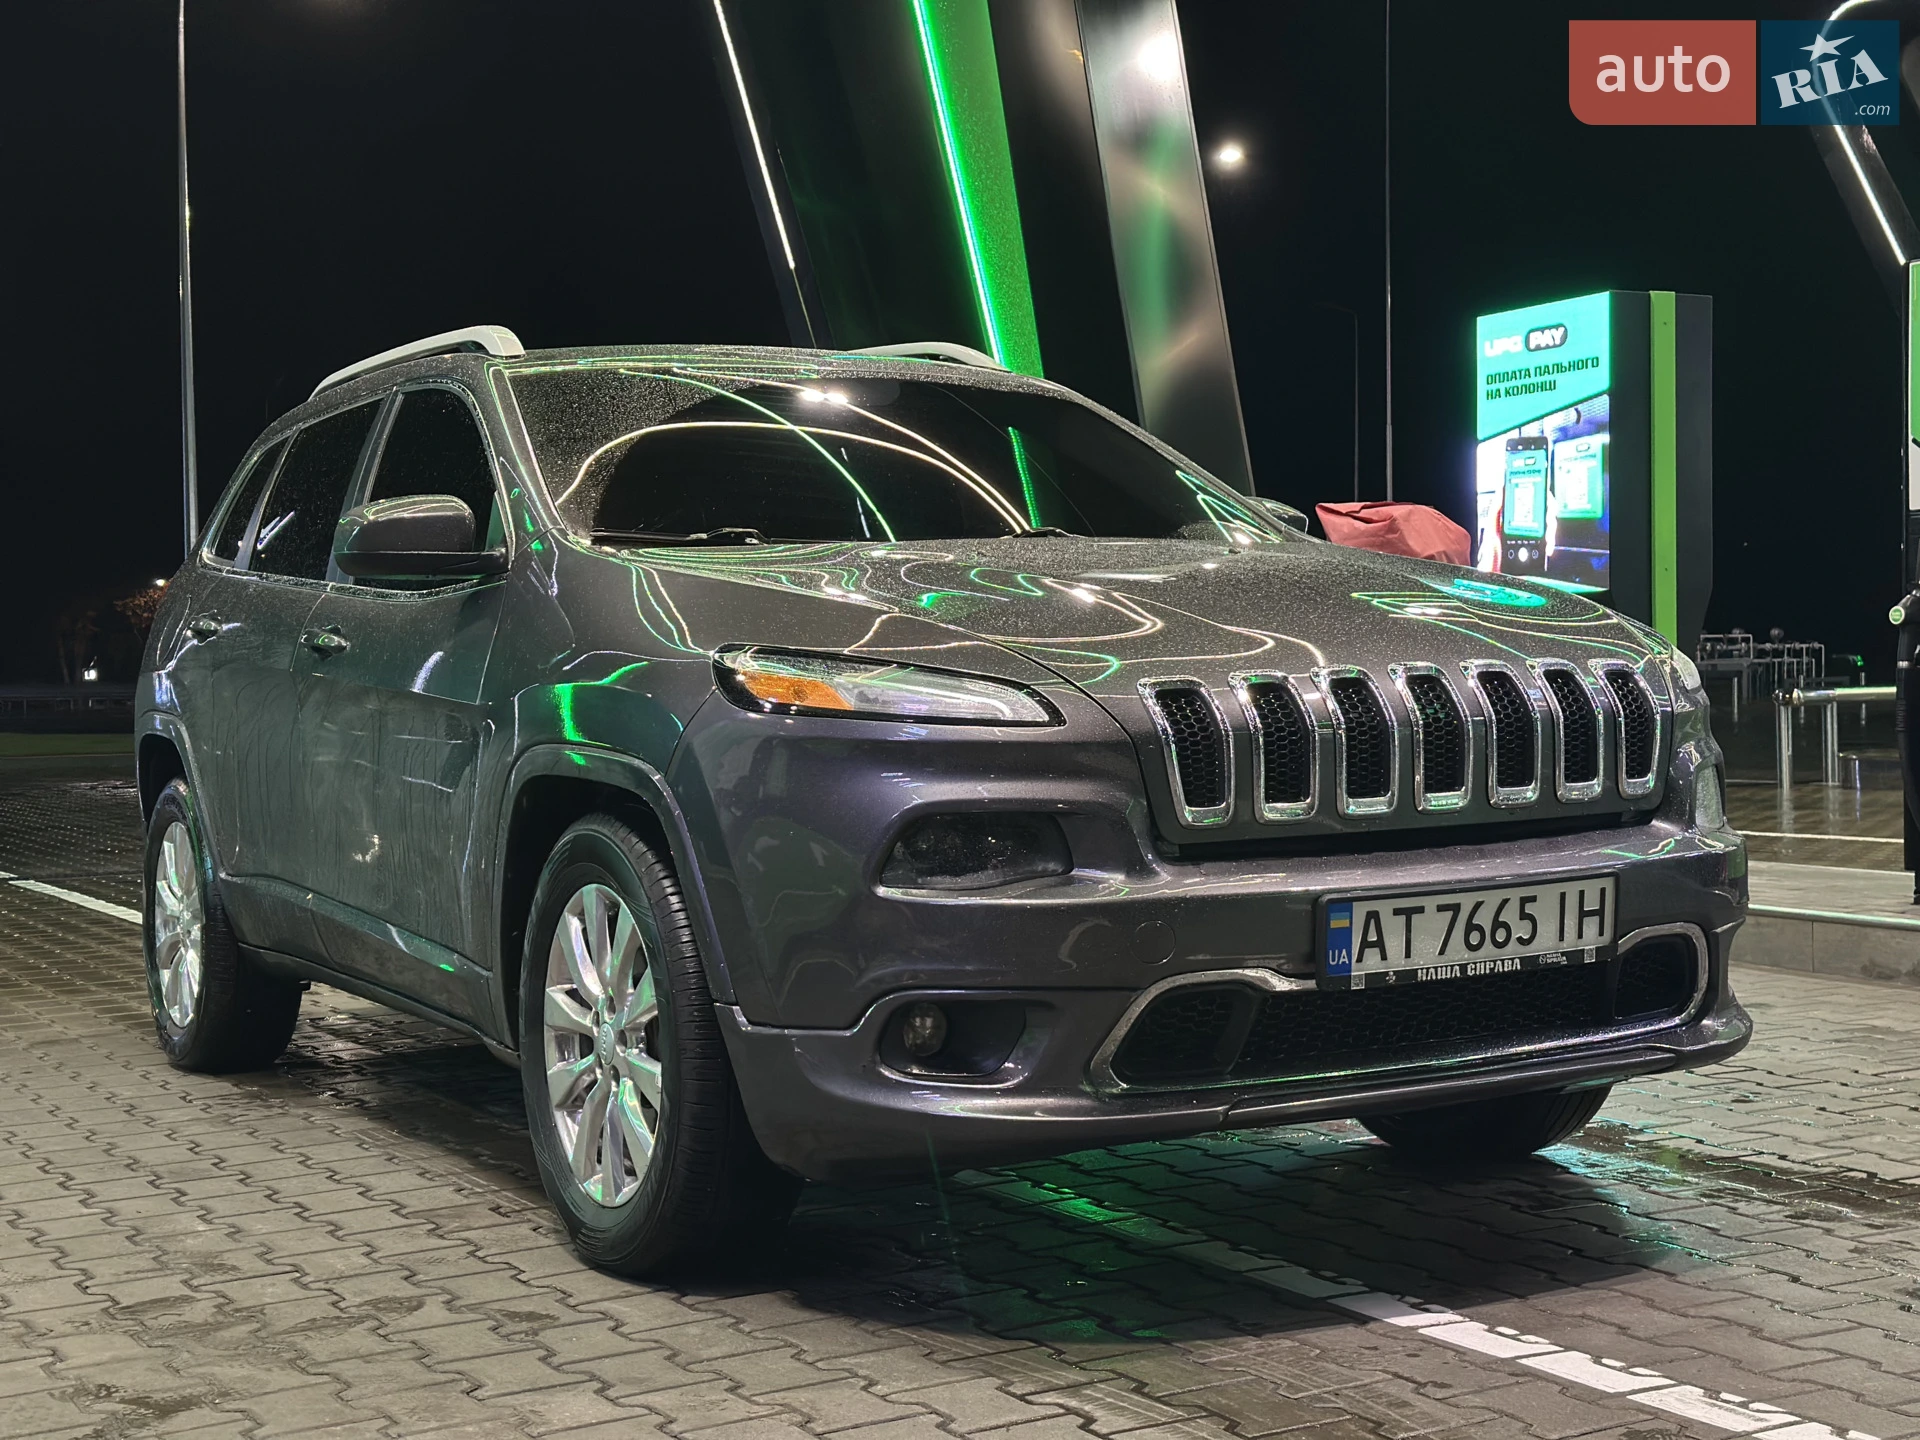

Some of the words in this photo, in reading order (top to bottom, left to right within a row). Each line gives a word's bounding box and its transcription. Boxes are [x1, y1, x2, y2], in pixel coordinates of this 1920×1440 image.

[1530, 327, 1565, 350] PAY
[1486, 369, 1531, 386] ОПЛАТА
[1534, 356, 1600, 377] ПАЛЬНОГО
[1486, 389, 1502, 401] НА
[1504, 379, 1557, 398] КОЛОНЦІ
[1355, 905, 1425, 963] AT
[1436, 894, 1538, 956] 7665
[1558, 887, 1606, 942] IH
[1329, 948, 1349, 965] UA
[1417, 964, 1460, 981] НАША
[1467, 958, 1521, 976] СПРАВА
